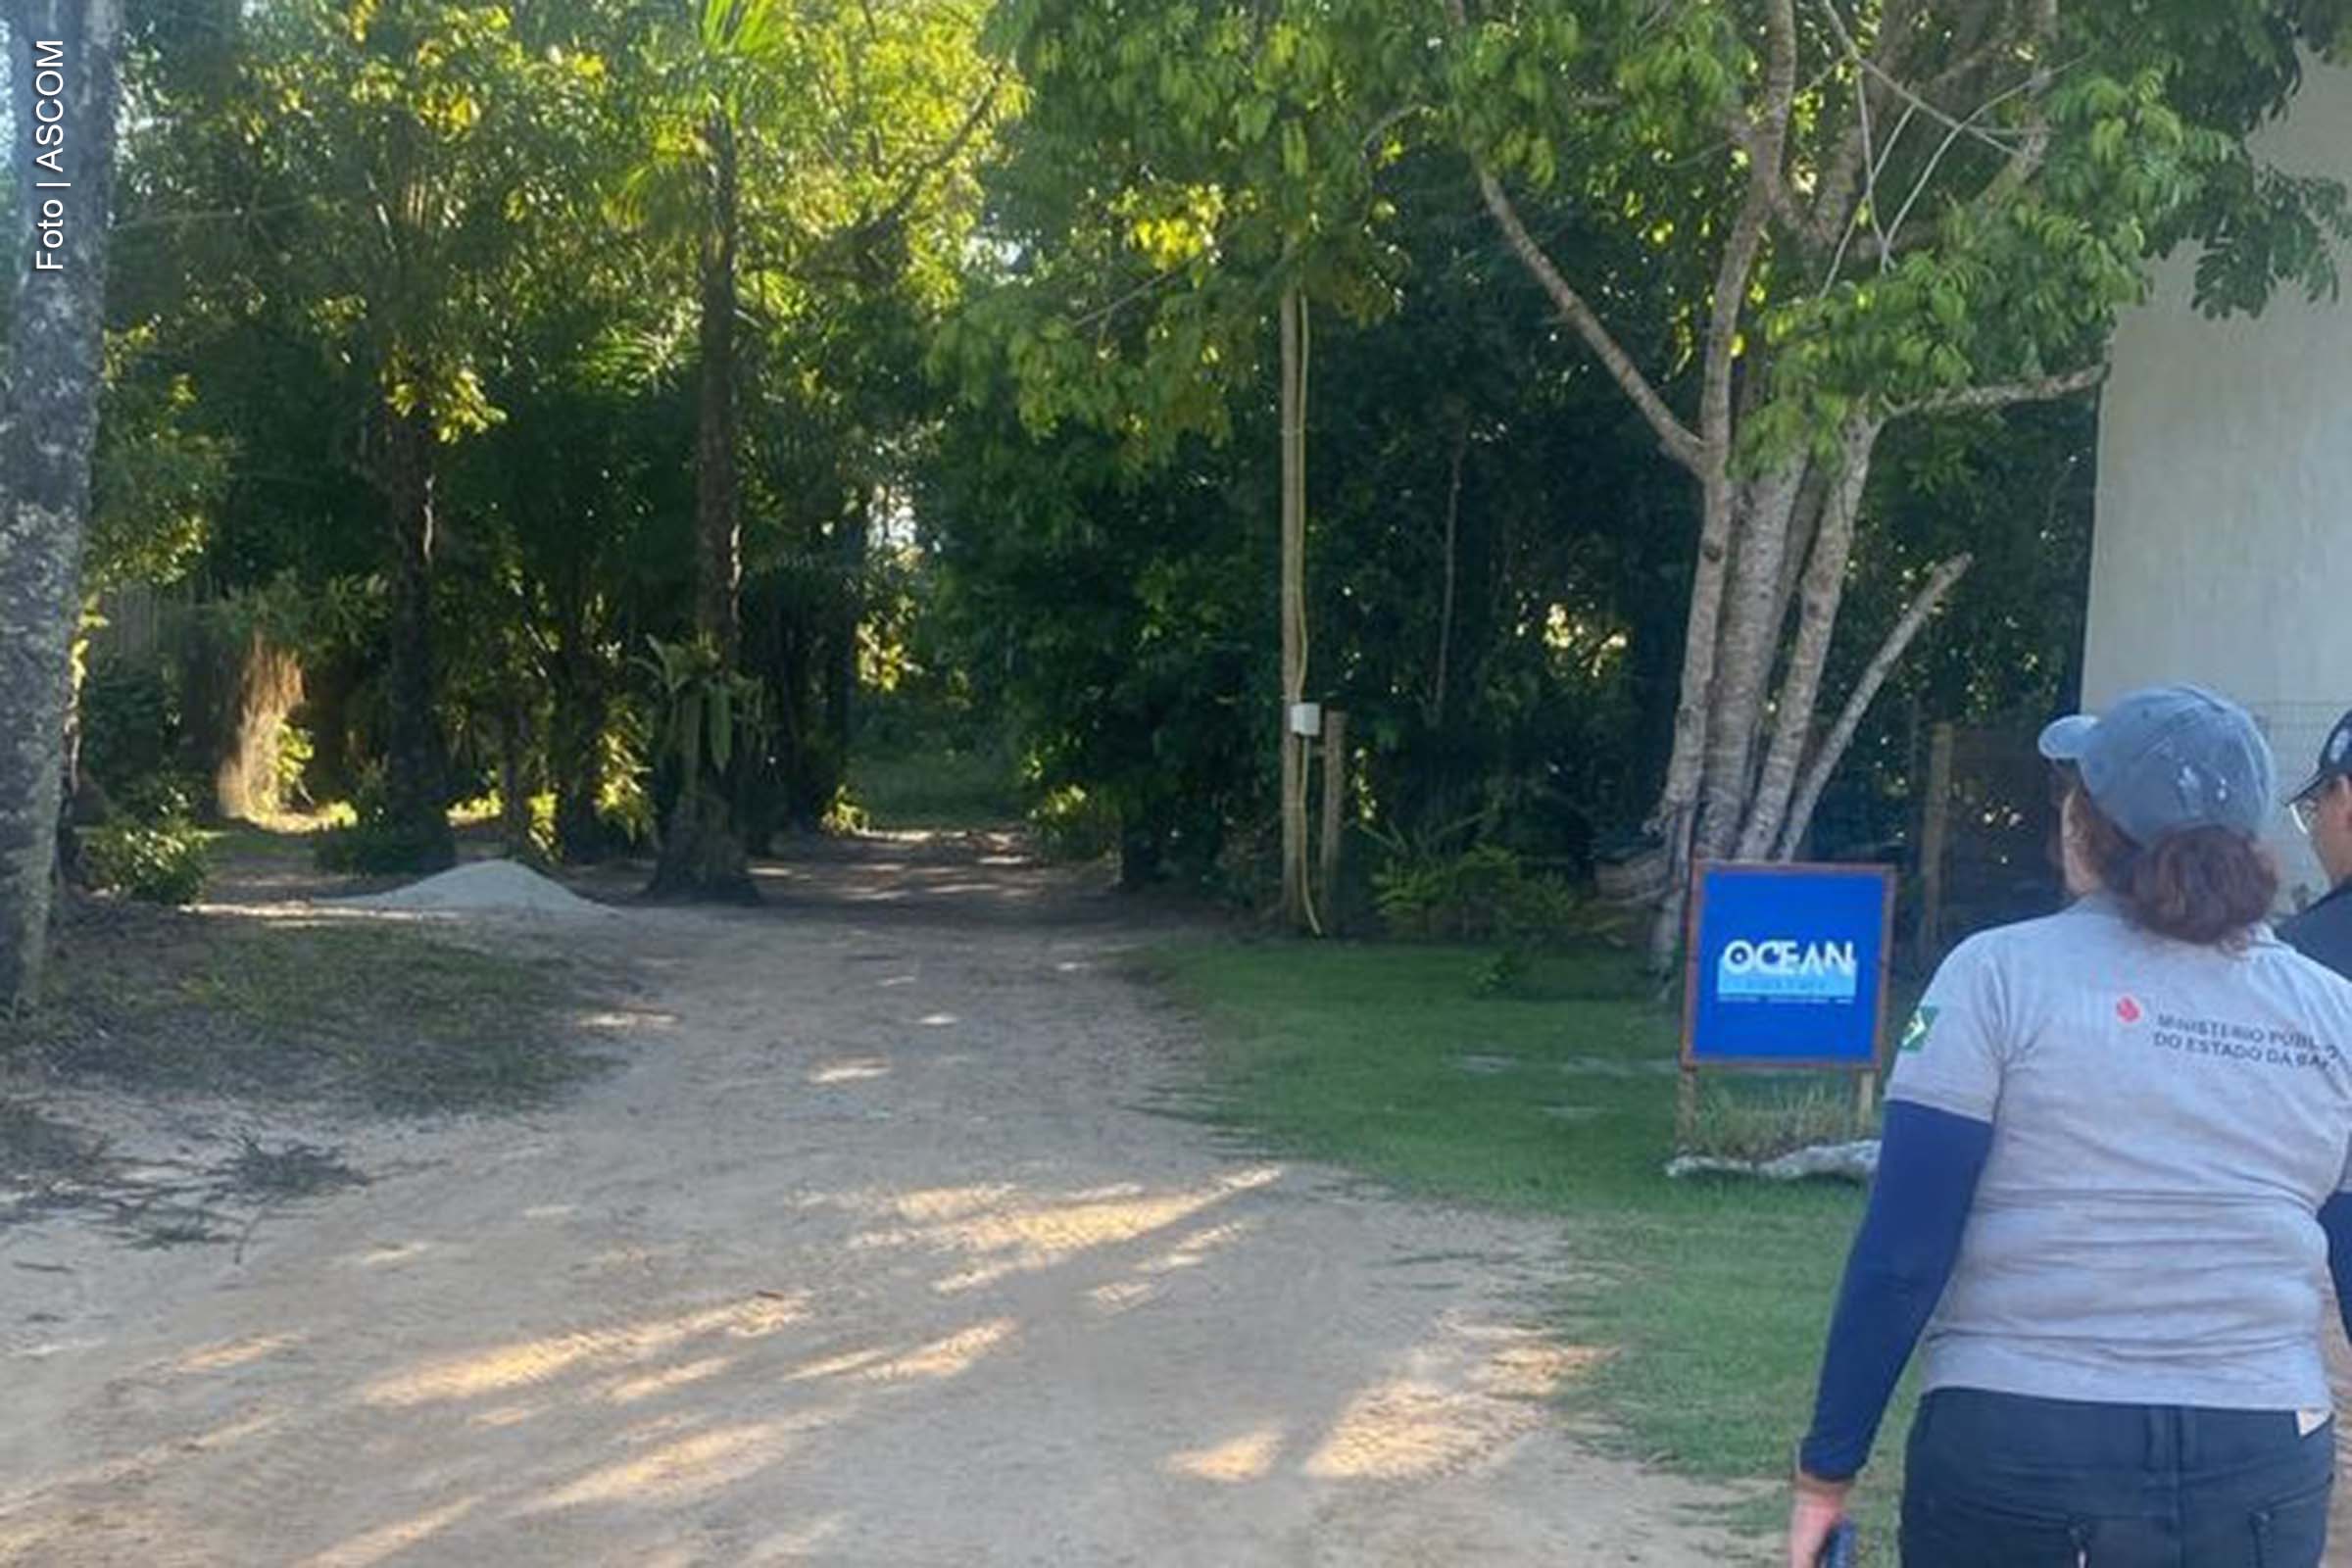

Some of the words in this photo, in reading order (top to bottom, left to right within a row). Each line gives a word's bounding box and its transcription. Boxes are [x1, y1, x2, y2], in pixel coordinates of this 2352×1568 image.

[1723, 939, 1855, 976] OCEAN
[2153, 1030, 2181, 1050] DO
[2186, 1036, 2262, 1062] ESTADO
[2266, 1048, 2293, 1068] DA
